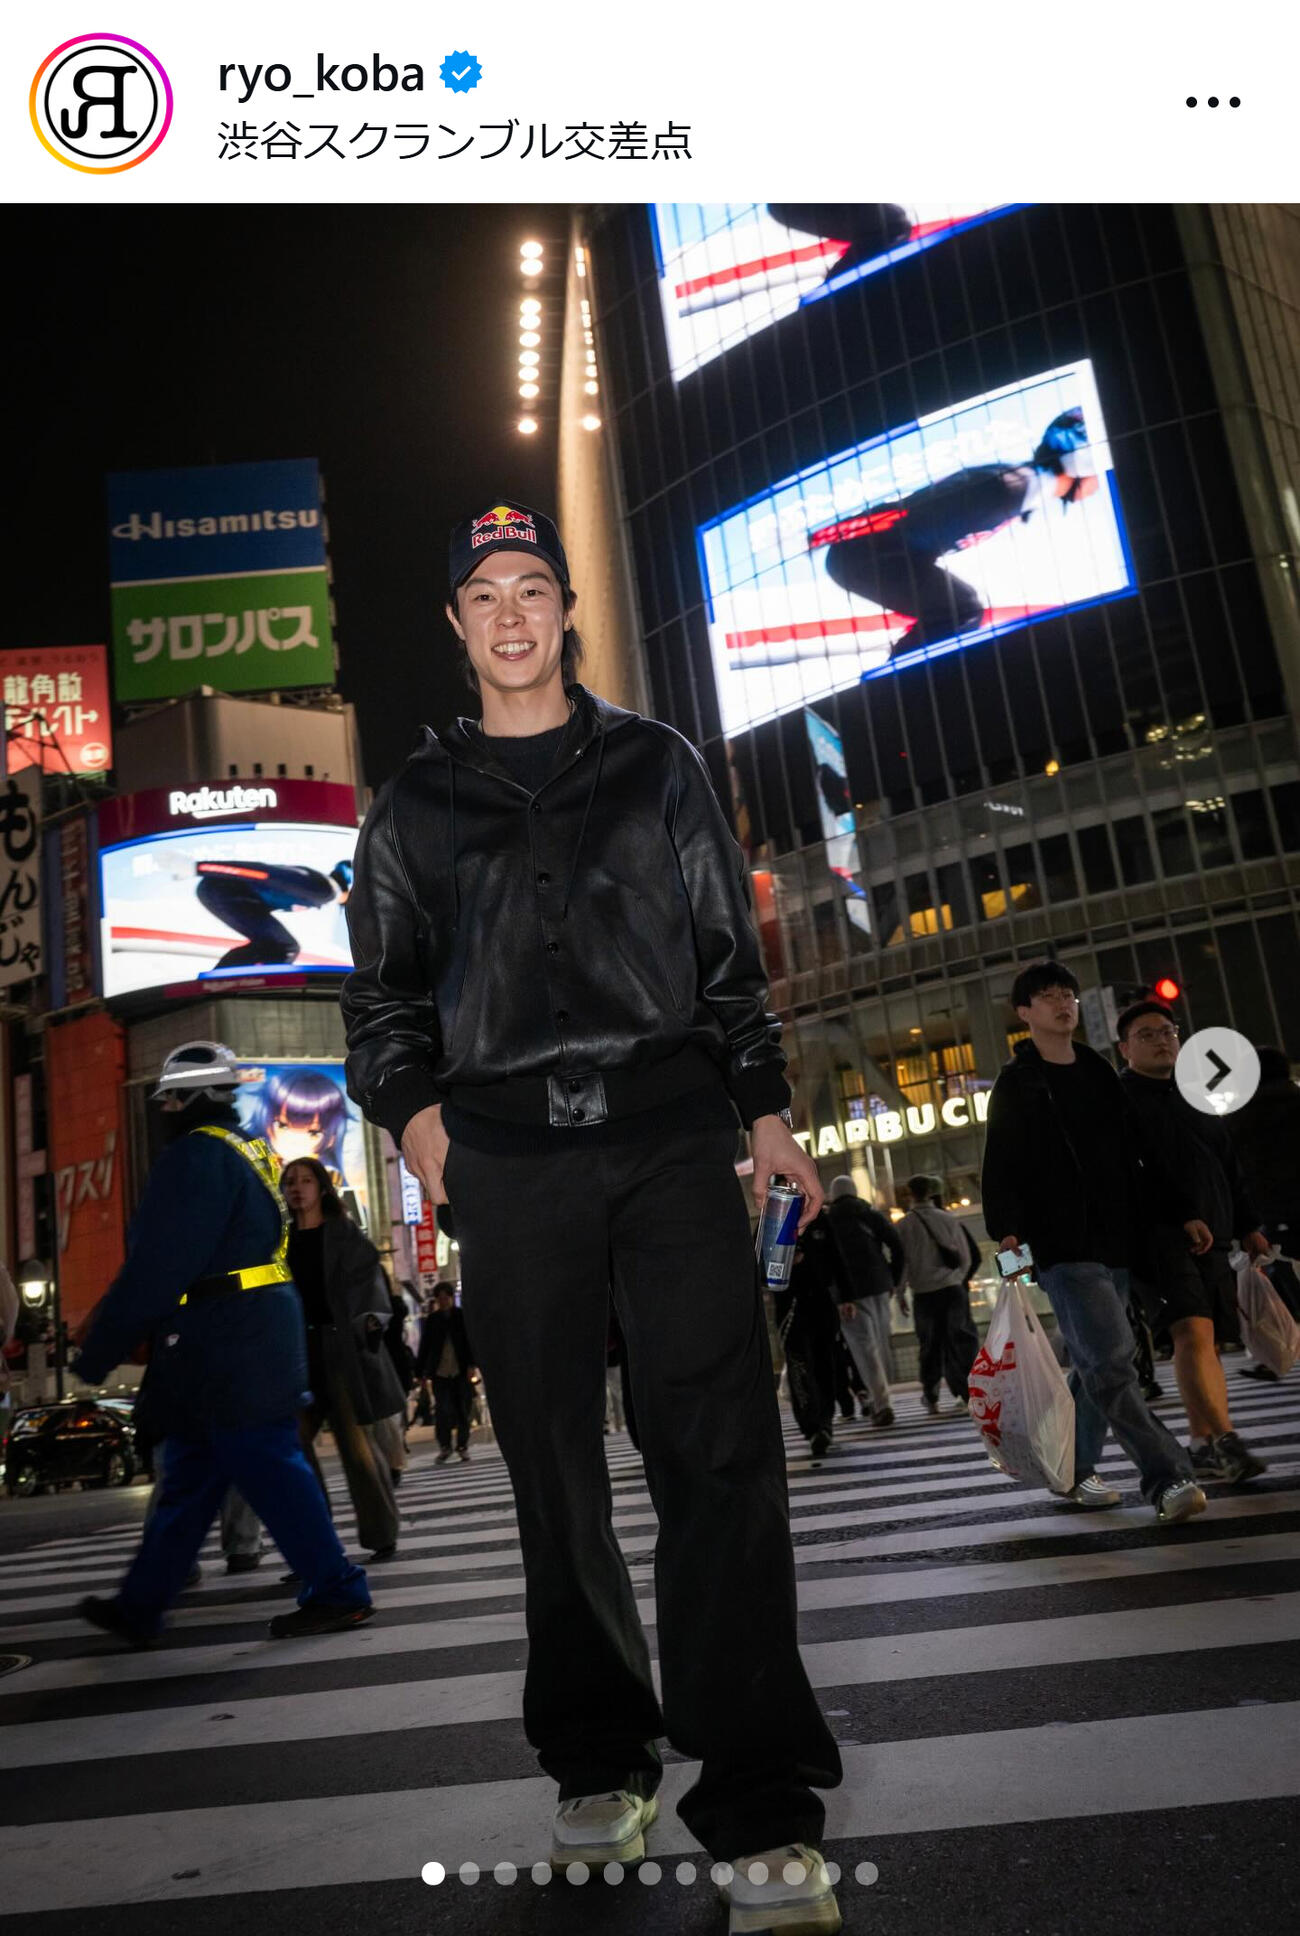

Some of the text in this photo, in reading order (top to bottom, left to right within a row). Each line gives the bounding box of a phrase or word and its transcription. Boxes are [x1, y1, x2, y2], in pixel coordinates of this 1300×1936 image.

[111, 508, 319, 541] Hisamitsu
[471, 526, 537, 549] Red Bull
[126, 605, 320, 663] サロンパス
[169, 785, 278, 816] Rakuten
